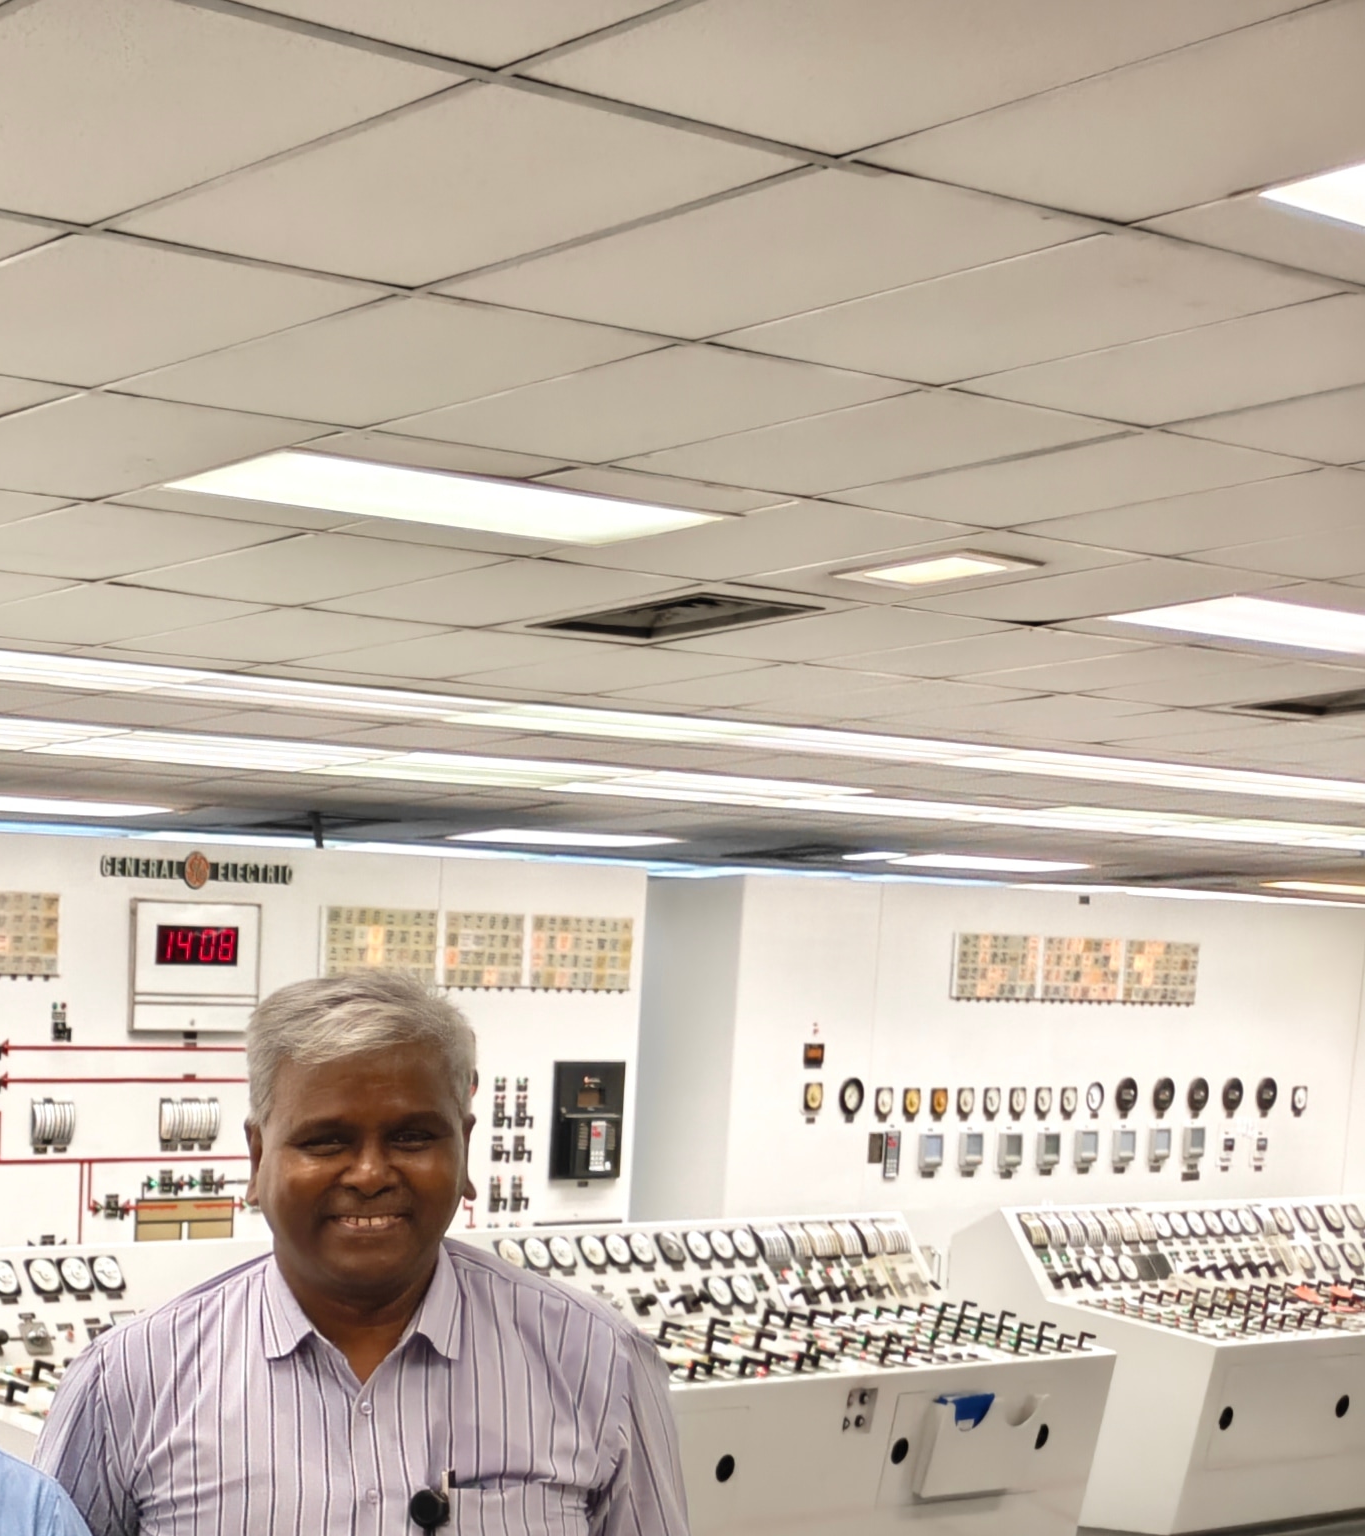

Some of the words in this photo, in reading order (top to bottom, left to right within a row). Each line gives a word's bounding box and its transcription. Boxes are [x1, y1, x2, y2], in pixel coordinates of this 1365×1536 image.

[101, 855, 181, 880] GENERAL
[217, 861, 293, 885] ELECTRIC
[165, 928, 237, 962] 1408
